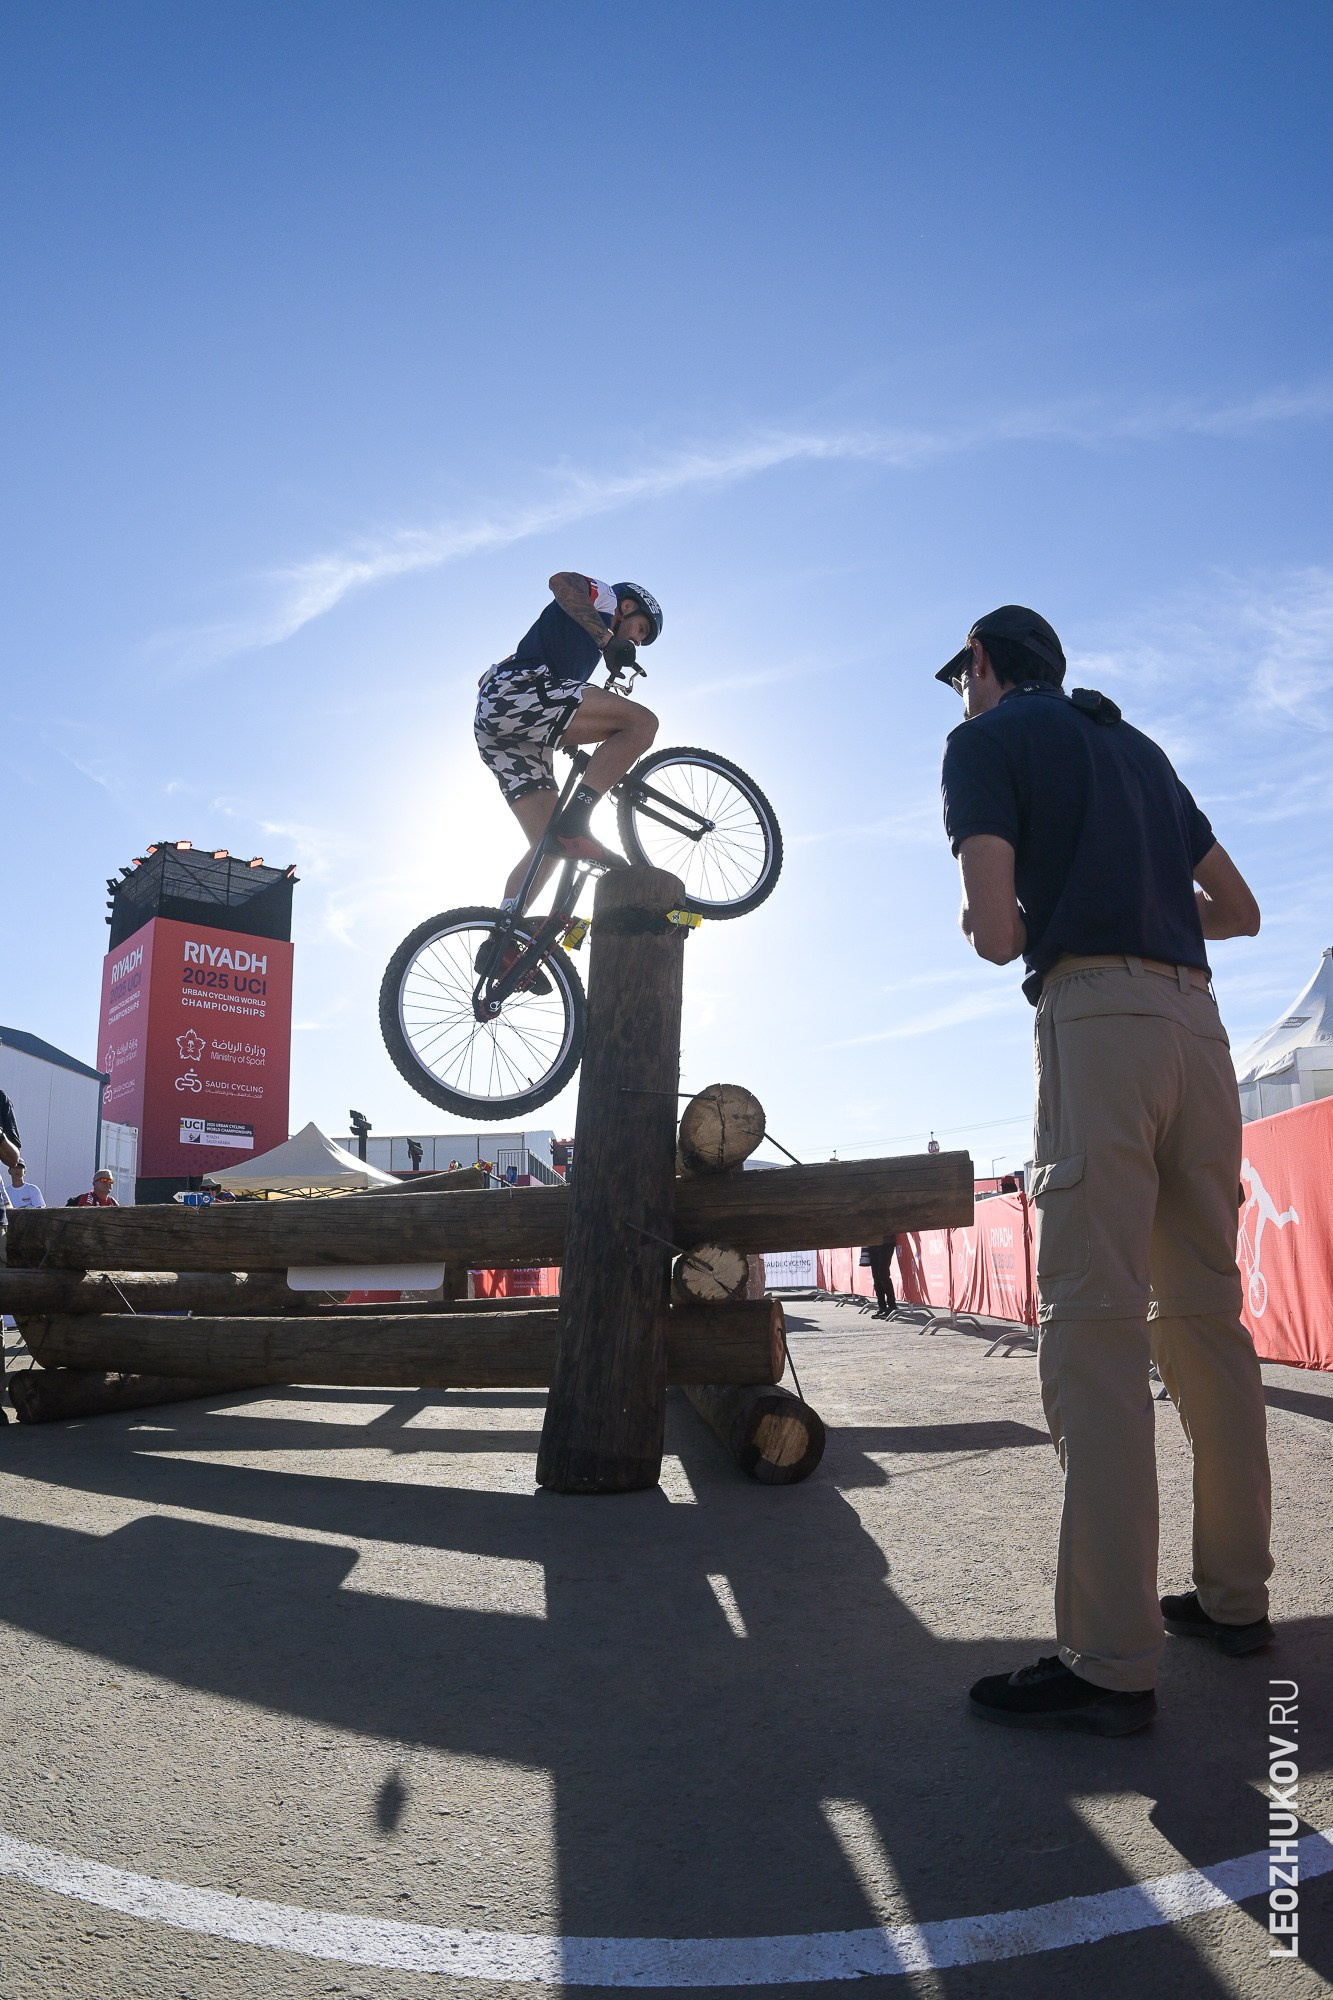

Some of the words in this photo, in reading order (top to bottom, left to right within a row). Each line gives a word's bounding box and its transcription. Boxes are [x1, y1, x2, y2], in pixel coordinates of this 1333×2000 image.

[577, 791, 593, 804] 23
[111, 944, 144, 985] RIYADH
[184, 941, 267, 975] RIYADH
[109, 981, 127, 1004] 2025
[127, 969, 142, 992] UCI
[183, 967, 229, 990] 2025
[233, 975, 267, 996] UCI
[182, 987, 208, 998] URBAN
[208, 991, 240, 1003] CYCLING
[240, 996, 266, 1007] WORLD
[181, 997, 266, 1018] CHAMPIONSHIPS
[211, 1039, 242, 1053] الرياضة
[244, 1043, 266, 1057] وزارة
[210, 1051, 237, 1064] Ministry
[237, 1055, 245, 1064] of
[246, 1056, 266, 1066] Sport
[205, 1080, 230, 1089] SAUDI
[231, 1083, 264, 1094] CYCLING
[184, 1120, 203, 1131] UCI
[990, 1227, 1013, 1248] RIYADH
[764, 1260, 782, 1268] AUDI
[783, 1259, 811, 1267] CYCLING
